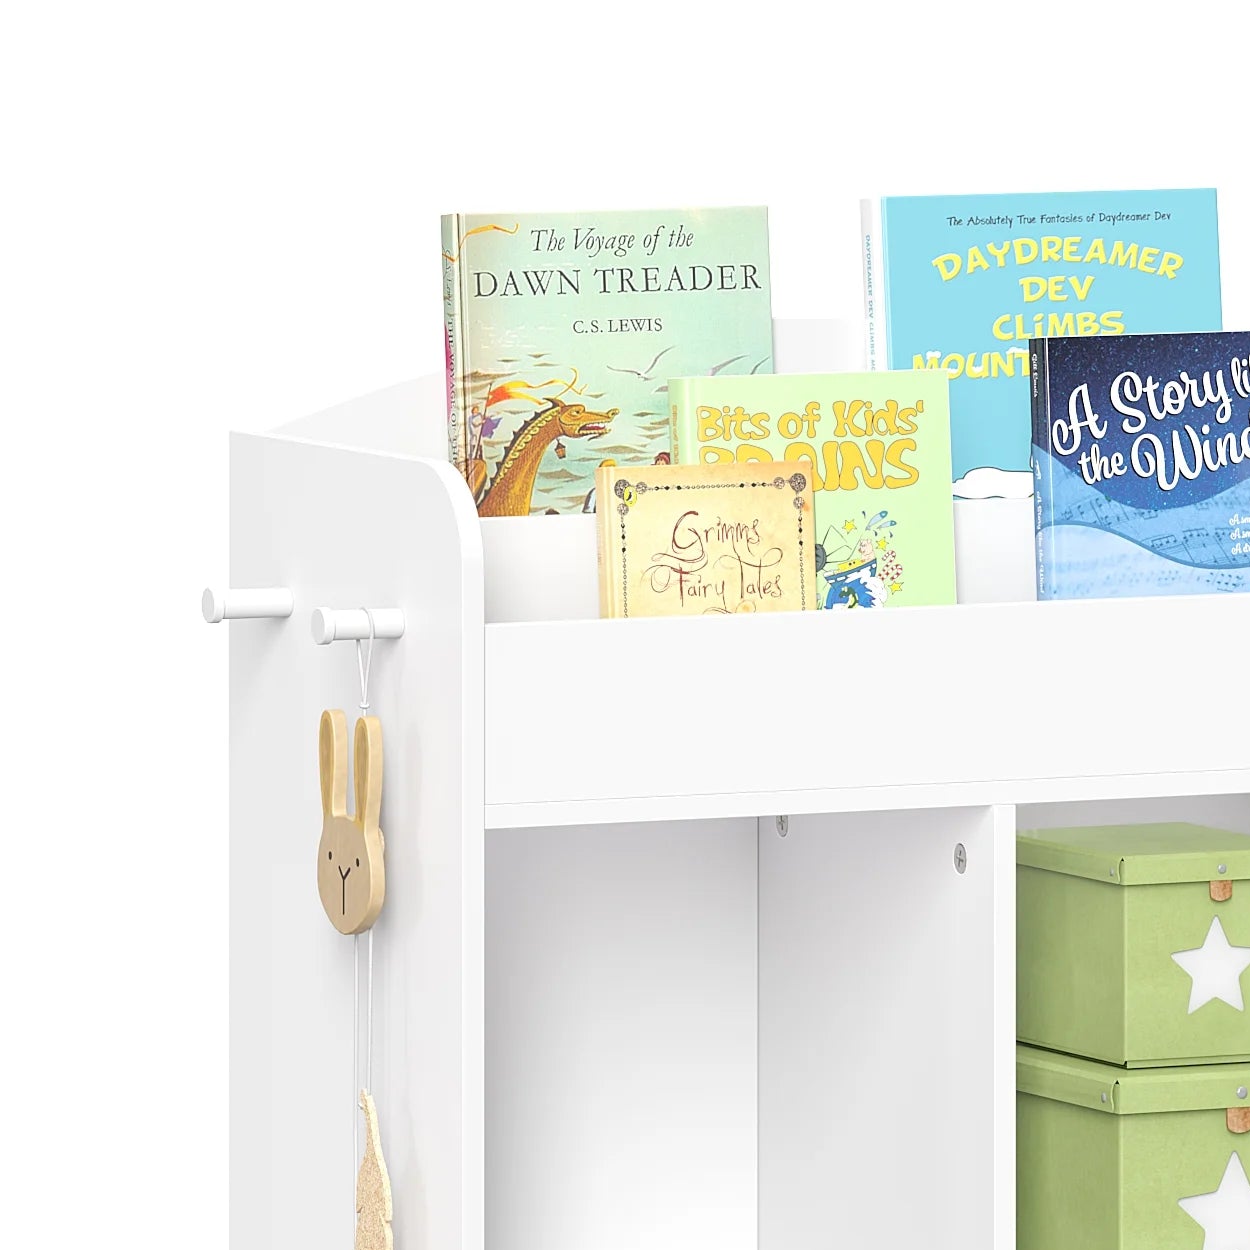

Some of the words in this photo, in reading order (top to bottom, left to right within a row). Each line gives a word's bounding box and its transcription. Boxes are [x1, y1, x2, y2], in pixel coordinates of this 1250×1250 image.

[947, 216, 963, 226] The
[966, 215, 1013, 229] Absolutely
[1017, 215, 1036, 224] True
[1040, 214, 1083, 224] Fantasies
[1086, 213, 1096, 222] of
[1099, 212, 1151, 226] Daydreamer
[1154, 211, 1171, 221] Dev
[530, 229, 565, 251] The
[573, 227, 636, 258] Voyage
[643, 225, 665, 256] of
[669, 224, 694, 248] the
[931, 235, 1185, 281] DAYDREAMER
[474, 269, 580, 298] DAWN
[593, 264, 762, 294] TREADER
[1019, 275, 1095, 304] DEV
[608, 318, 663, 333] LEWIS
[696, 405, 770, 441] Bits
[777, 401, 821, 439] of
[832, 400, 924, 438] Kids'
[1052, 383, 1107, 456] A
[1110, 370, 1232, 434] Story
[1079, 445, 1127, 485] the
[672, 511, 761, 554] Grimms
[1229, 513, 1240, 525] A
[1230, 528, 1240, 540] A
[1231, 543, 1242, 555] A
[651, 563, 726, 608] Fairy
[711, 547, 784, 600] Tales
